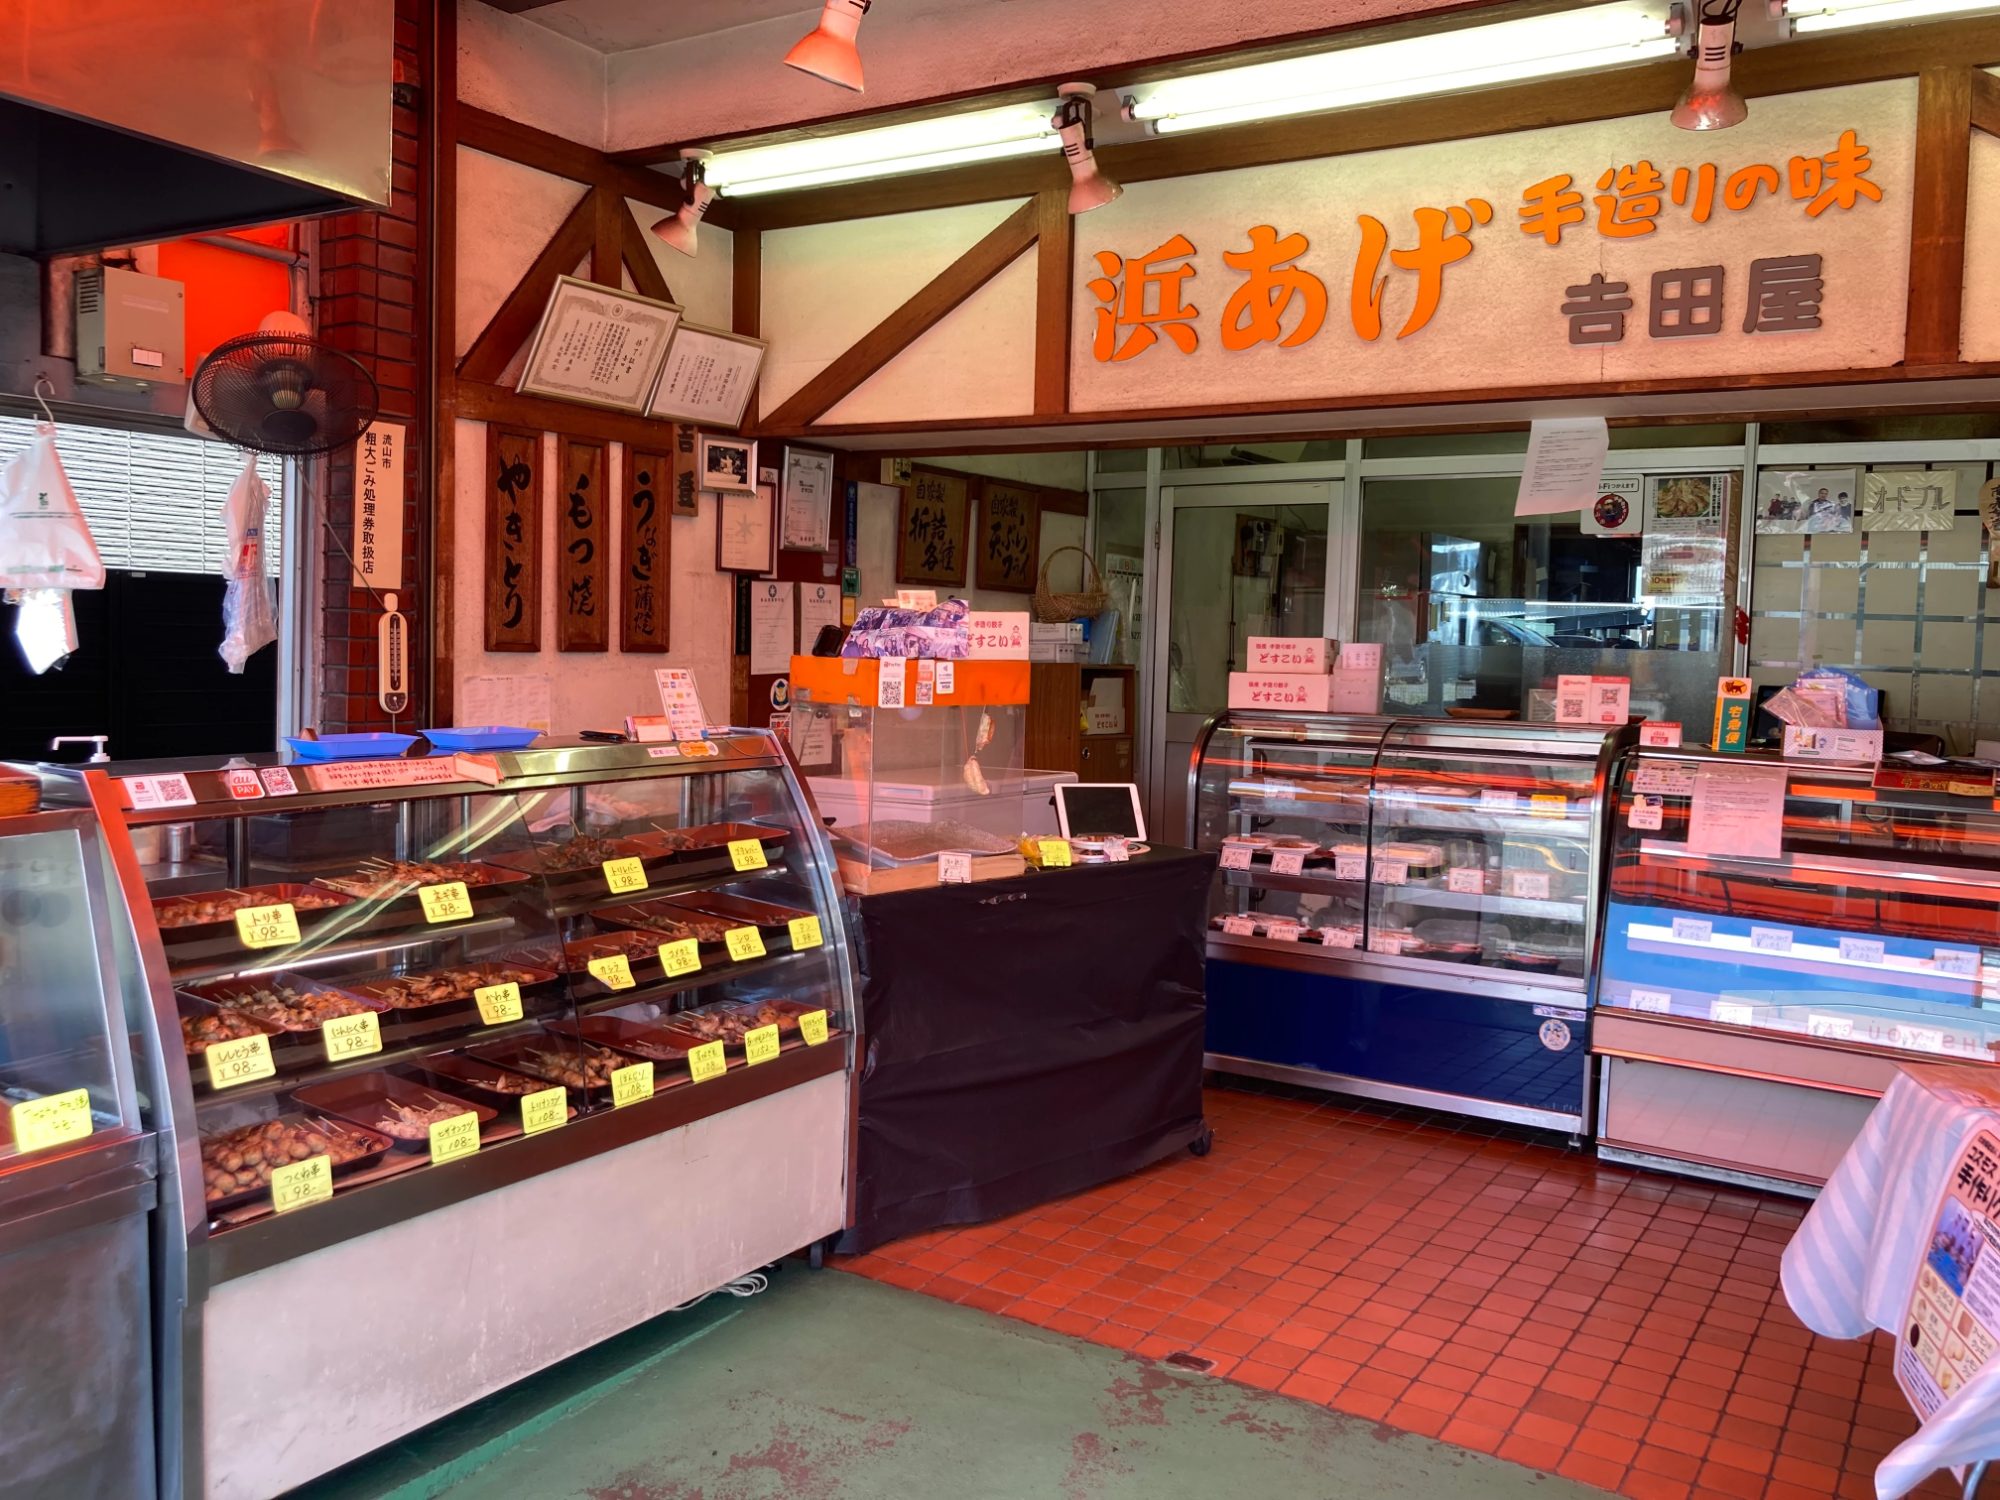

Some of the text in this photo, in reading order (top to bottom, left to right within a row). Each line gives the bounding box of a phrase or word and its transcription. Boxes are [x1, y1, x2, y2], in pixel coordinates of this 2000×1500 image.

[1518, 128, 1883, 244] 手造りの味
[1086, 197, 1493, 362] 浜あげ
[1560, 253, 1824, 346] 吉田屋
[382, 434, 392, 469] 流山市
[362, 431, 377, 574] 粗大ごみ処理券取扱店
[497, 453, 531, 629] やきとり
[1259, 653, 1302, 664] どすこい
[1251, 691, 1294, 702] どすこい
[1726, 705, 1743, 744] 宅急便
[237, 786, 254, 794] PAY
[252, 908, 281, 926] トリ串
[1967, 1146, 1998, 1179] コスモス
